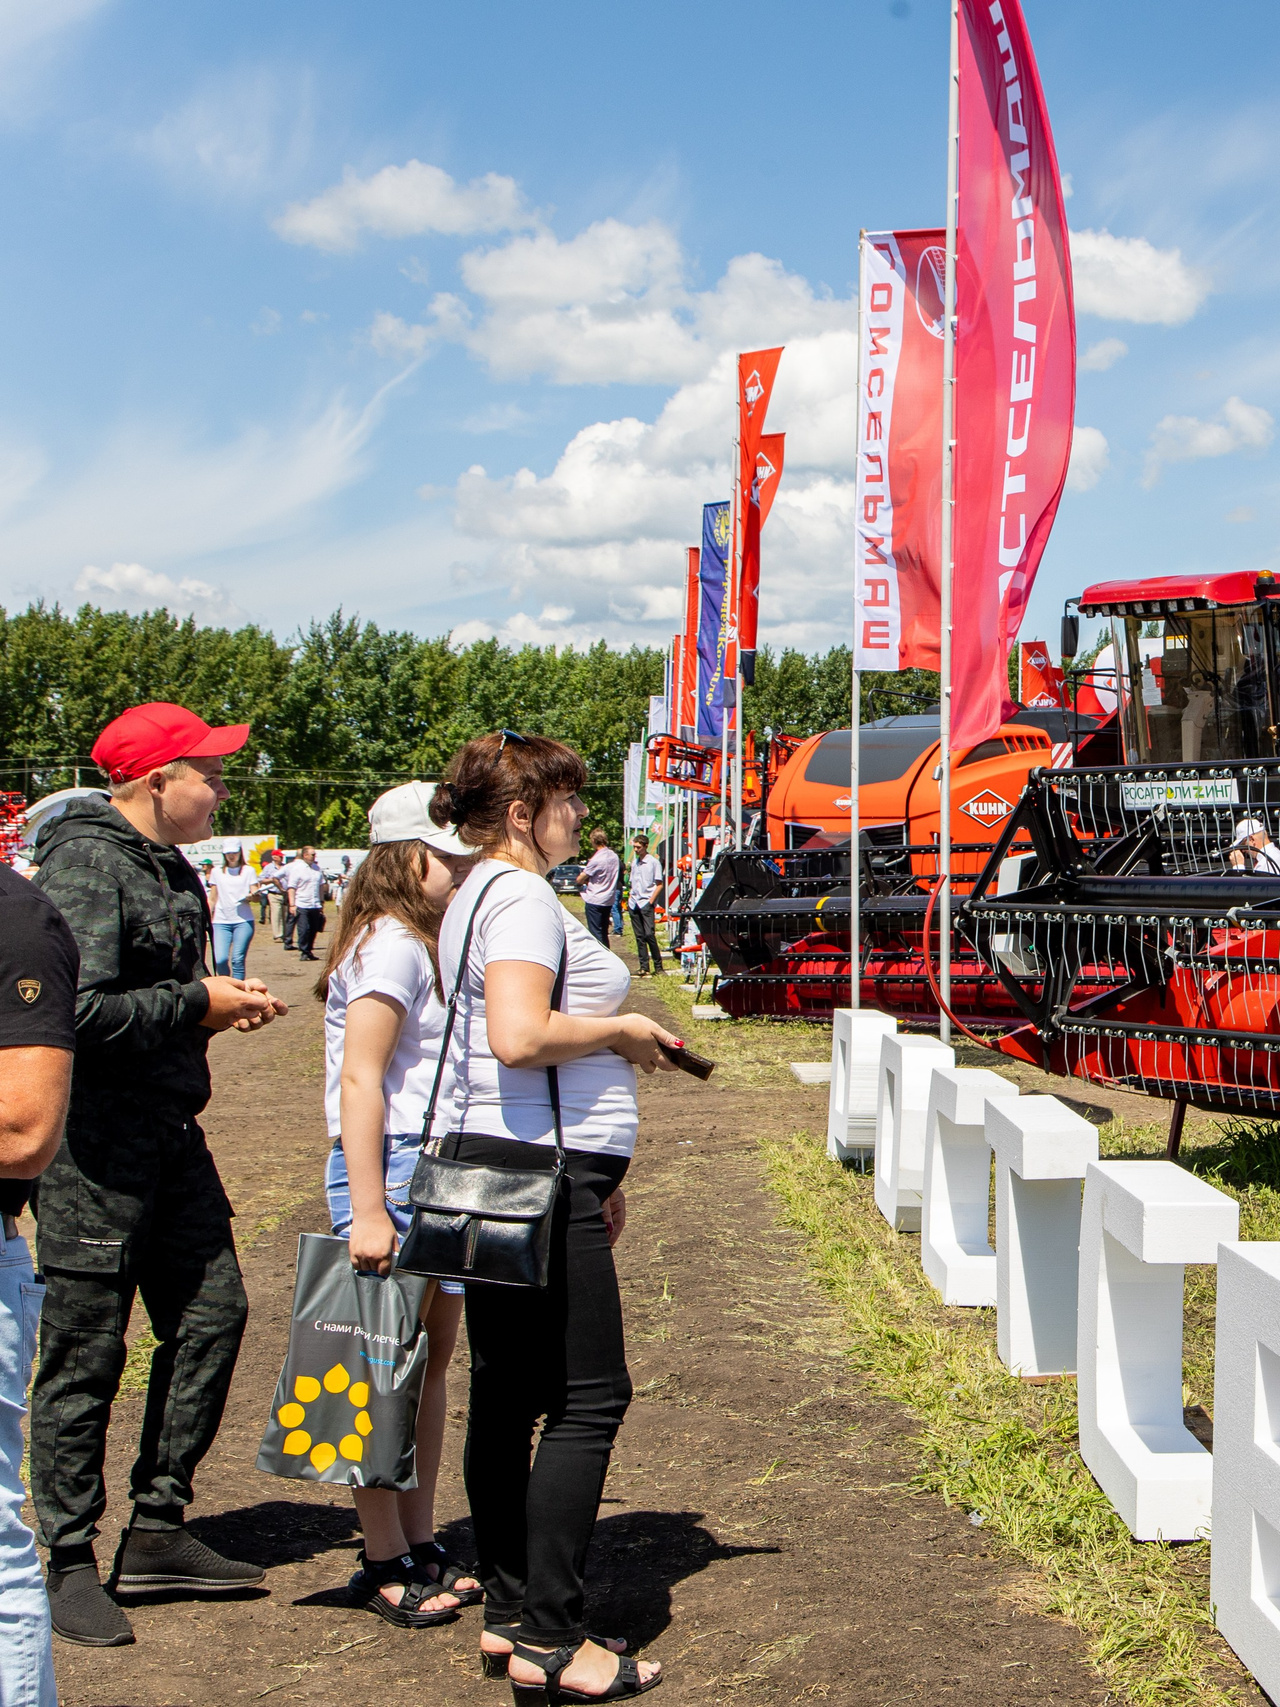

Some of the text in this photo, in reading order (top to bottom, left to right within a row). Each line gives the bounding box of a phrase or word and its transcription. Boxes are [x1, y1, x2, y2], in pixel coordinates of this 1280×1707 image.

[988, 0, 1037, 635] ОСТСЕЛЬМАШ
[861, 242, 895, 650] ГОМСЕЛЬМАШ
[968, 802, 1007, 815] KUHN
[314, 1320, 322, 1331] С
[323, 1322, 352, 1333] нами
[372, 1333, 400, 1346] легче
